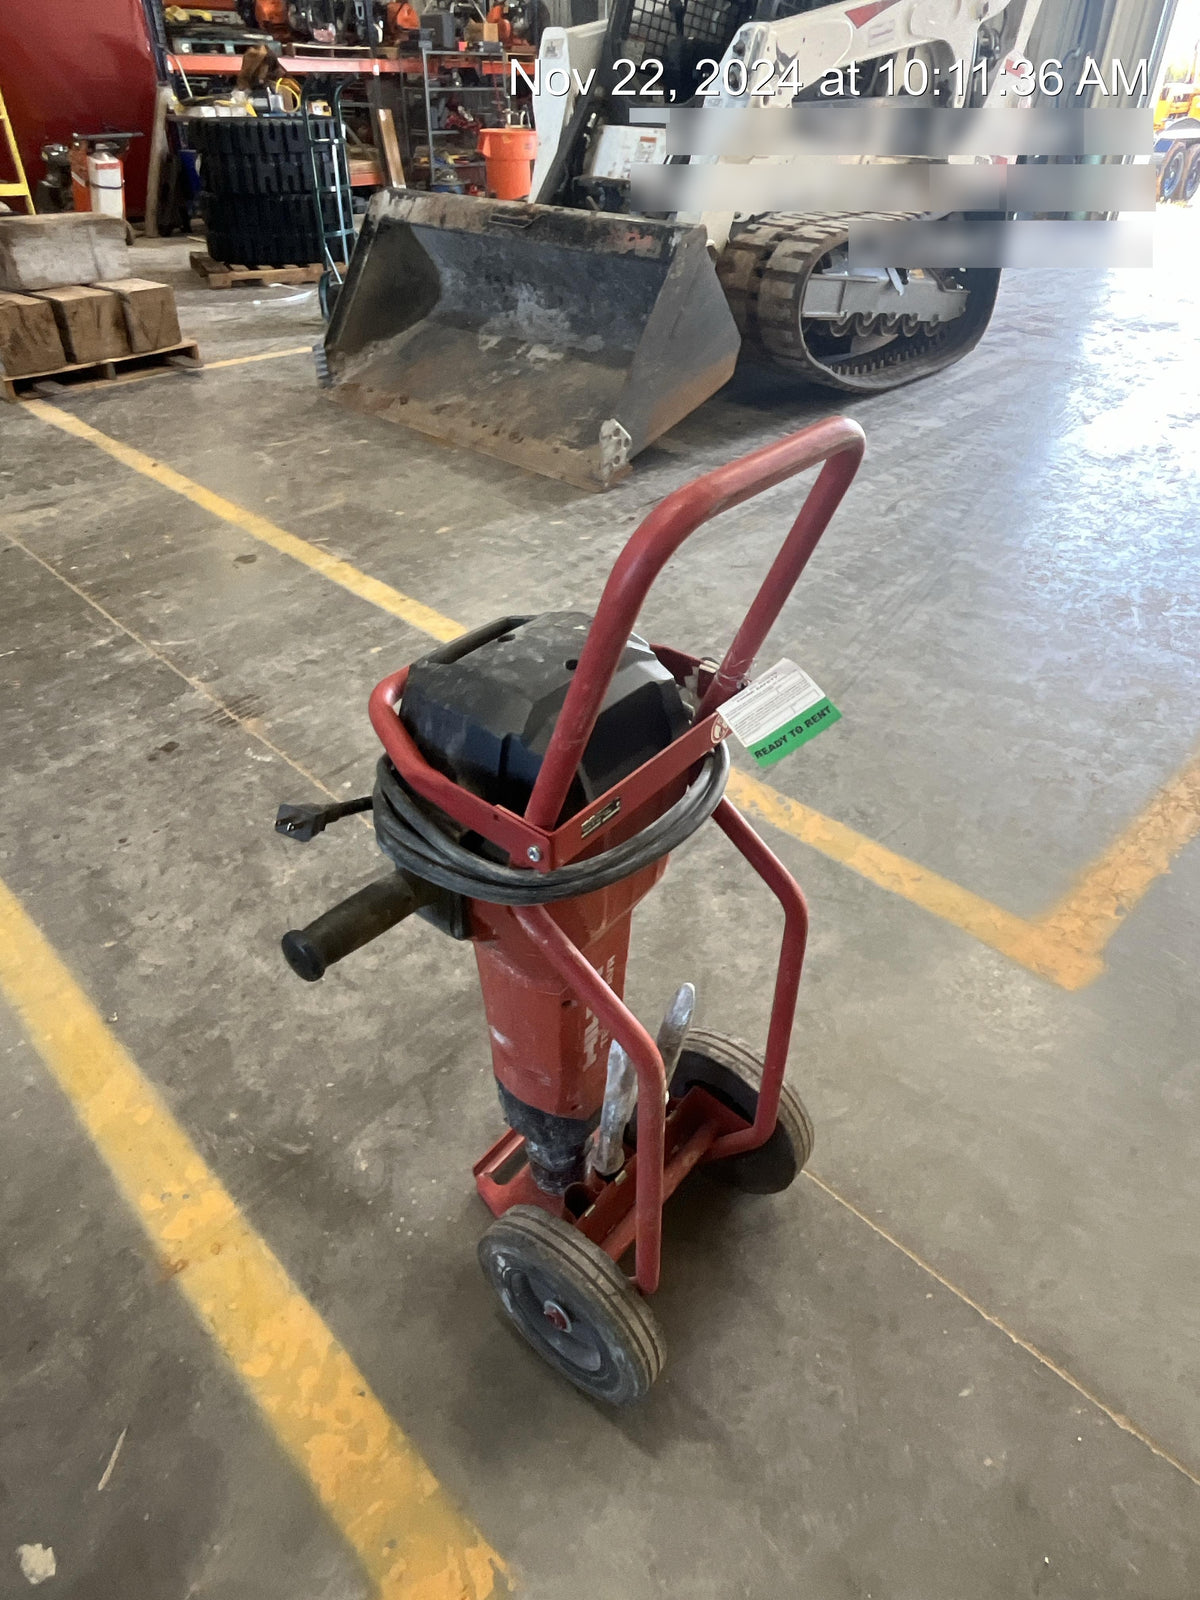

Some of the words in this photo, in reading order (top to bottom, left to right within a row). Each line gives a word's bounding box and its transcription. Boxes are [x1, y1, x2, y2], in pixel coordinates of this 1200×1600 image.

[754, 735, 788, 759] READY
[788, 725, 804, 738] TO
[804, 706, 831, 728] RENT
